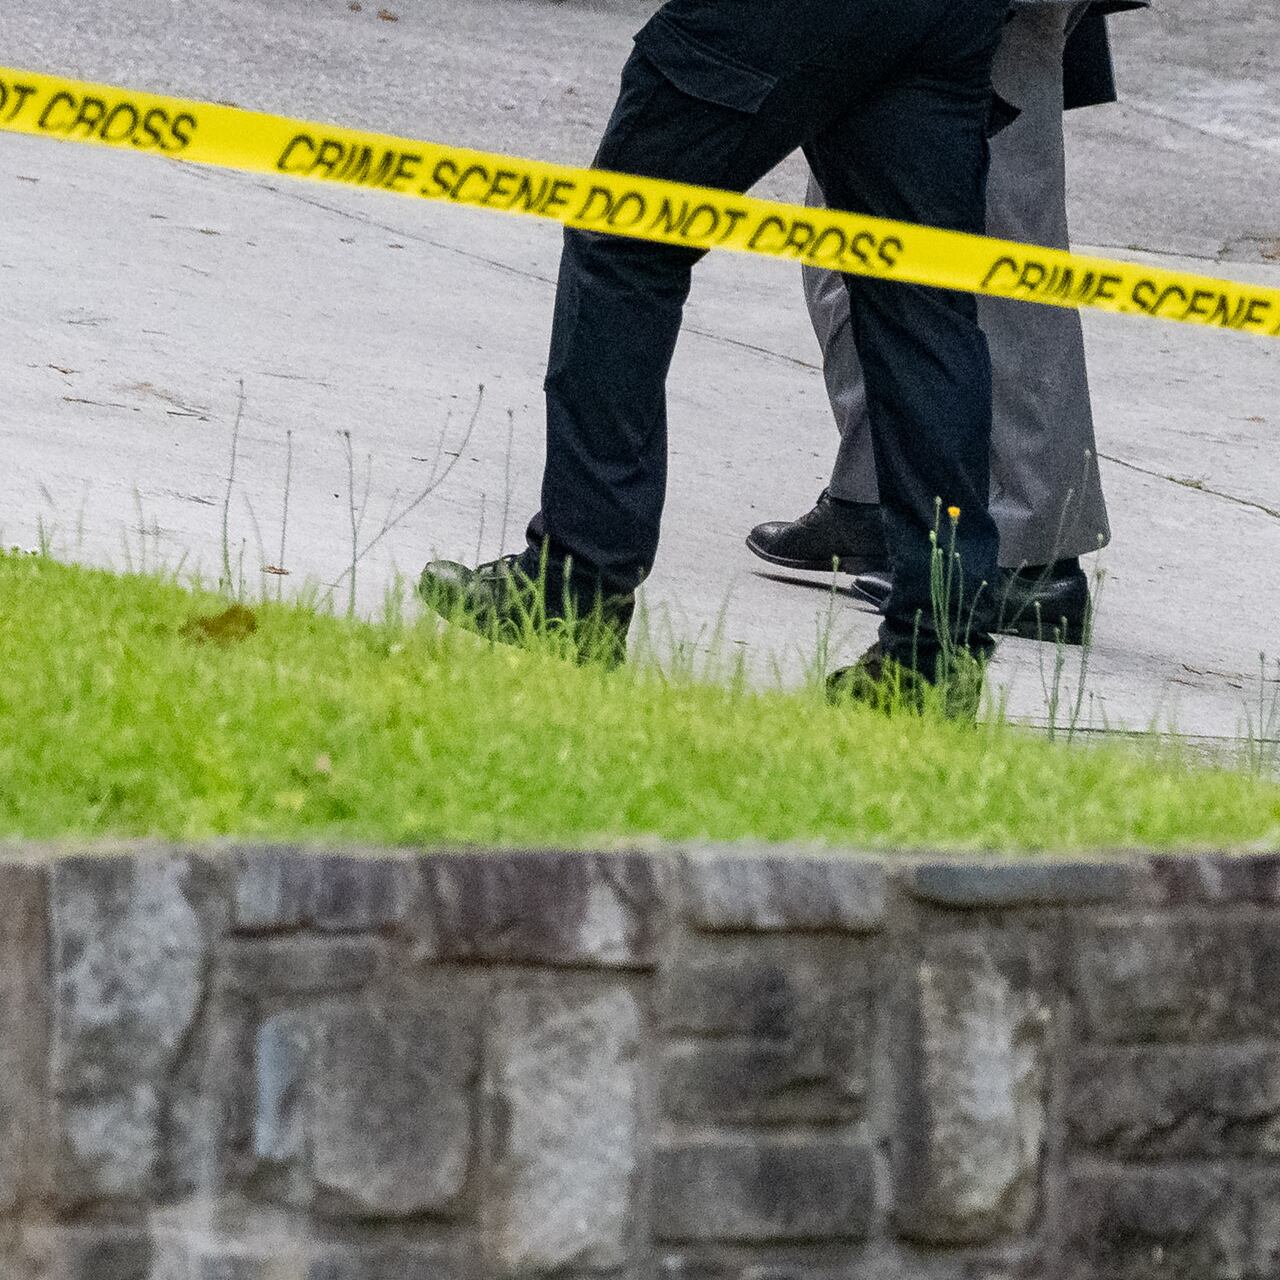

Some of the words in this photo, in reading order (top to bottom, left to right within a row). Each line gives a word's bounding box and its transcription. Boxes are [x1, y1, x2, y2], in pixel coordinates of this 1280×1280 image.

[37, 91, 198, 152] CROSS
[277, 133, 421, 191] CRIME
[420, 158, 576, 218] SCENE
[574, 185, 646, 226] DO
[651, 196, 748, 243] NOT
[747, 215, 904, 268] CROSS
[980, 256, 1122, 305] CRIME
[1119, 279, 1271, 329] SCENE
